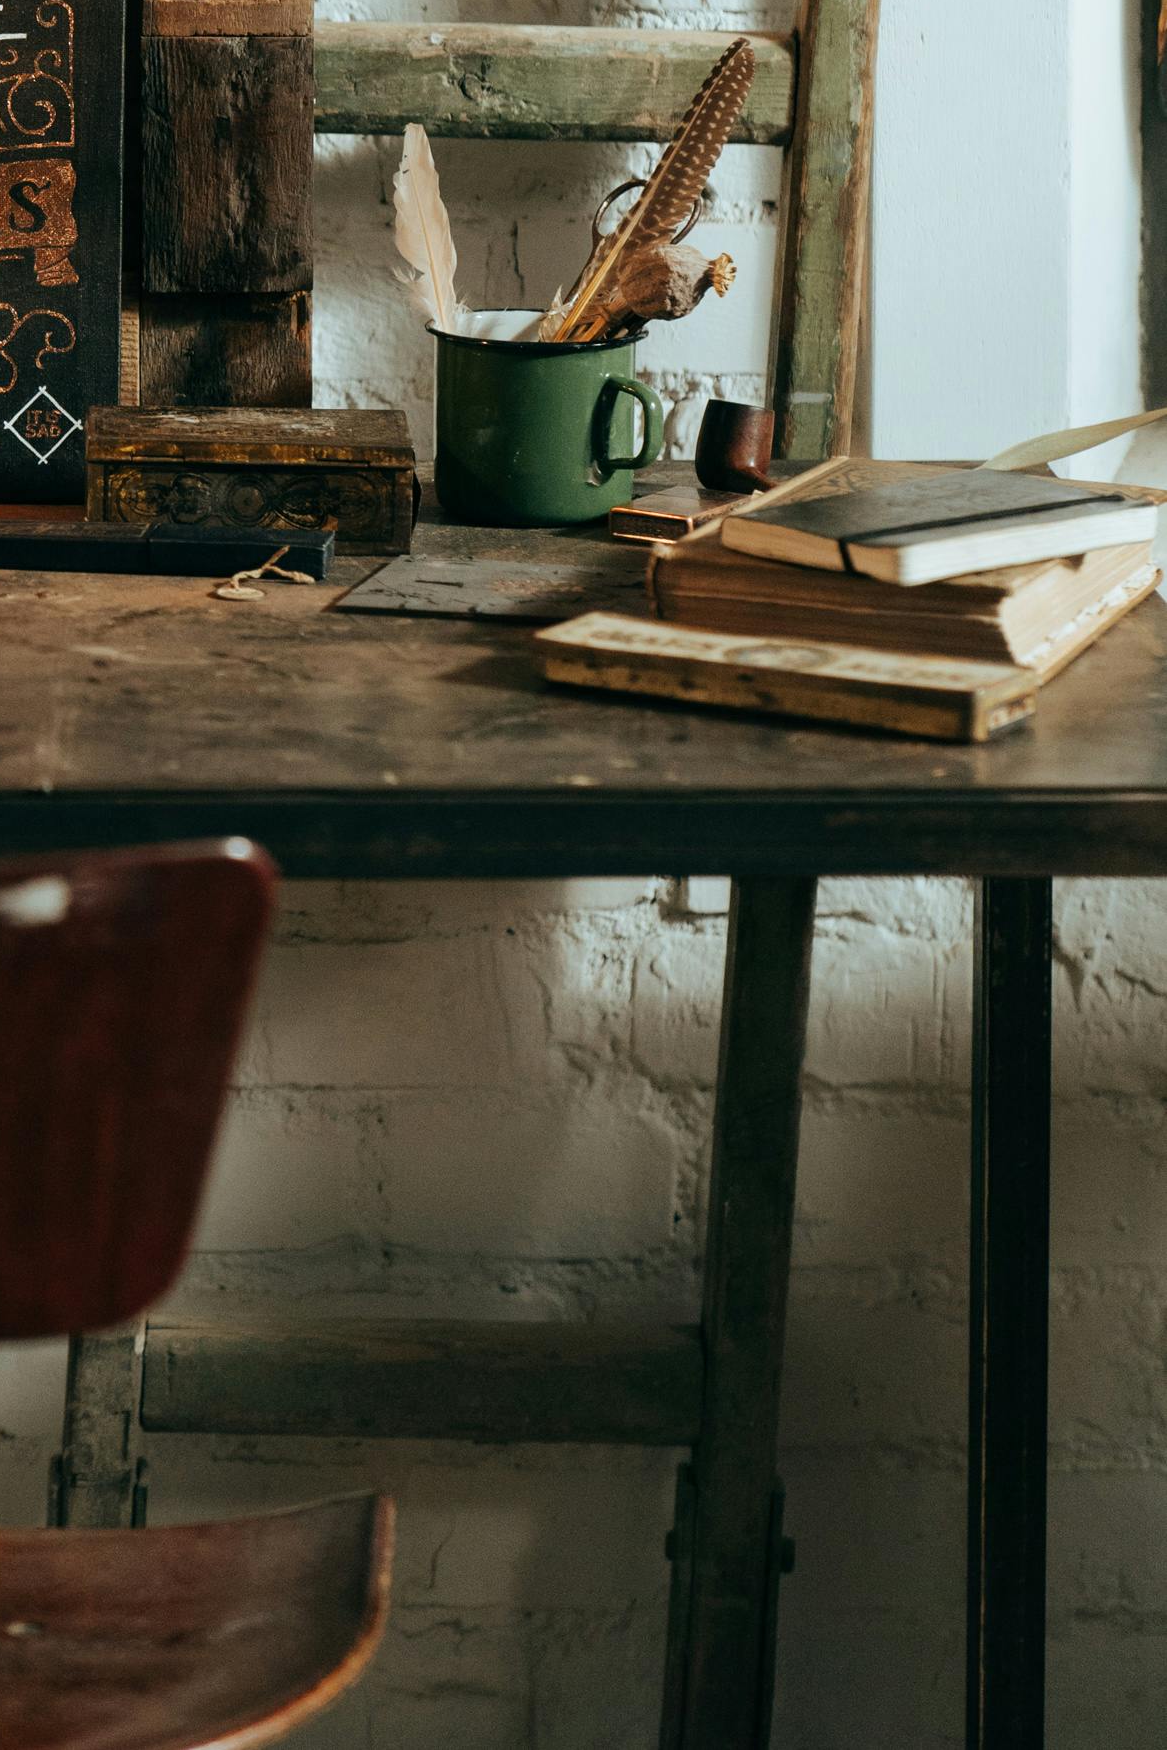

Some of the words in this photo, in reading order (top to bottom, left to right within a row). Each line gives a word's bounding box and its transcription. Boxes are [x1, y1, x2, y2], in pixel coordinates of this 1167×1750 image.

[26, 410, 42, 424] IT
[46, 410, 62, 423] IS
[25, 424, 64, 438] SAD
